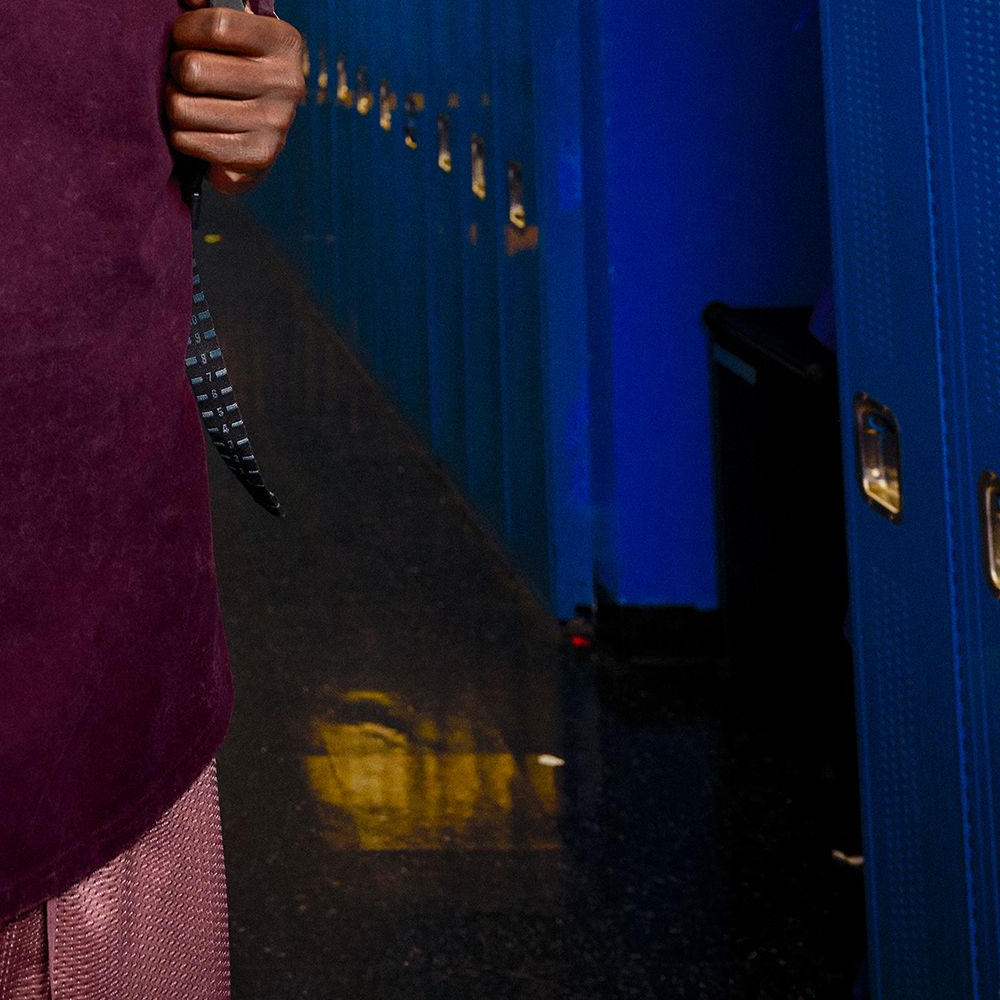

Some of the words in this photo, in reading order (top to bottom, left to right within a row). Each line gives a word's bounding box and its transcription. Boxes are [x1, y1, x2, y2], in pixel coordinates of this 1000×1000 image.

[194, 332, 202, 344] 9
[200, 353, 208, 365] 8
[206, 372, 213, 382] 7
[211, 388, 218, 399] 6
[216, 406, 224, 417] 5
[222, 423, 230, 434] 4
